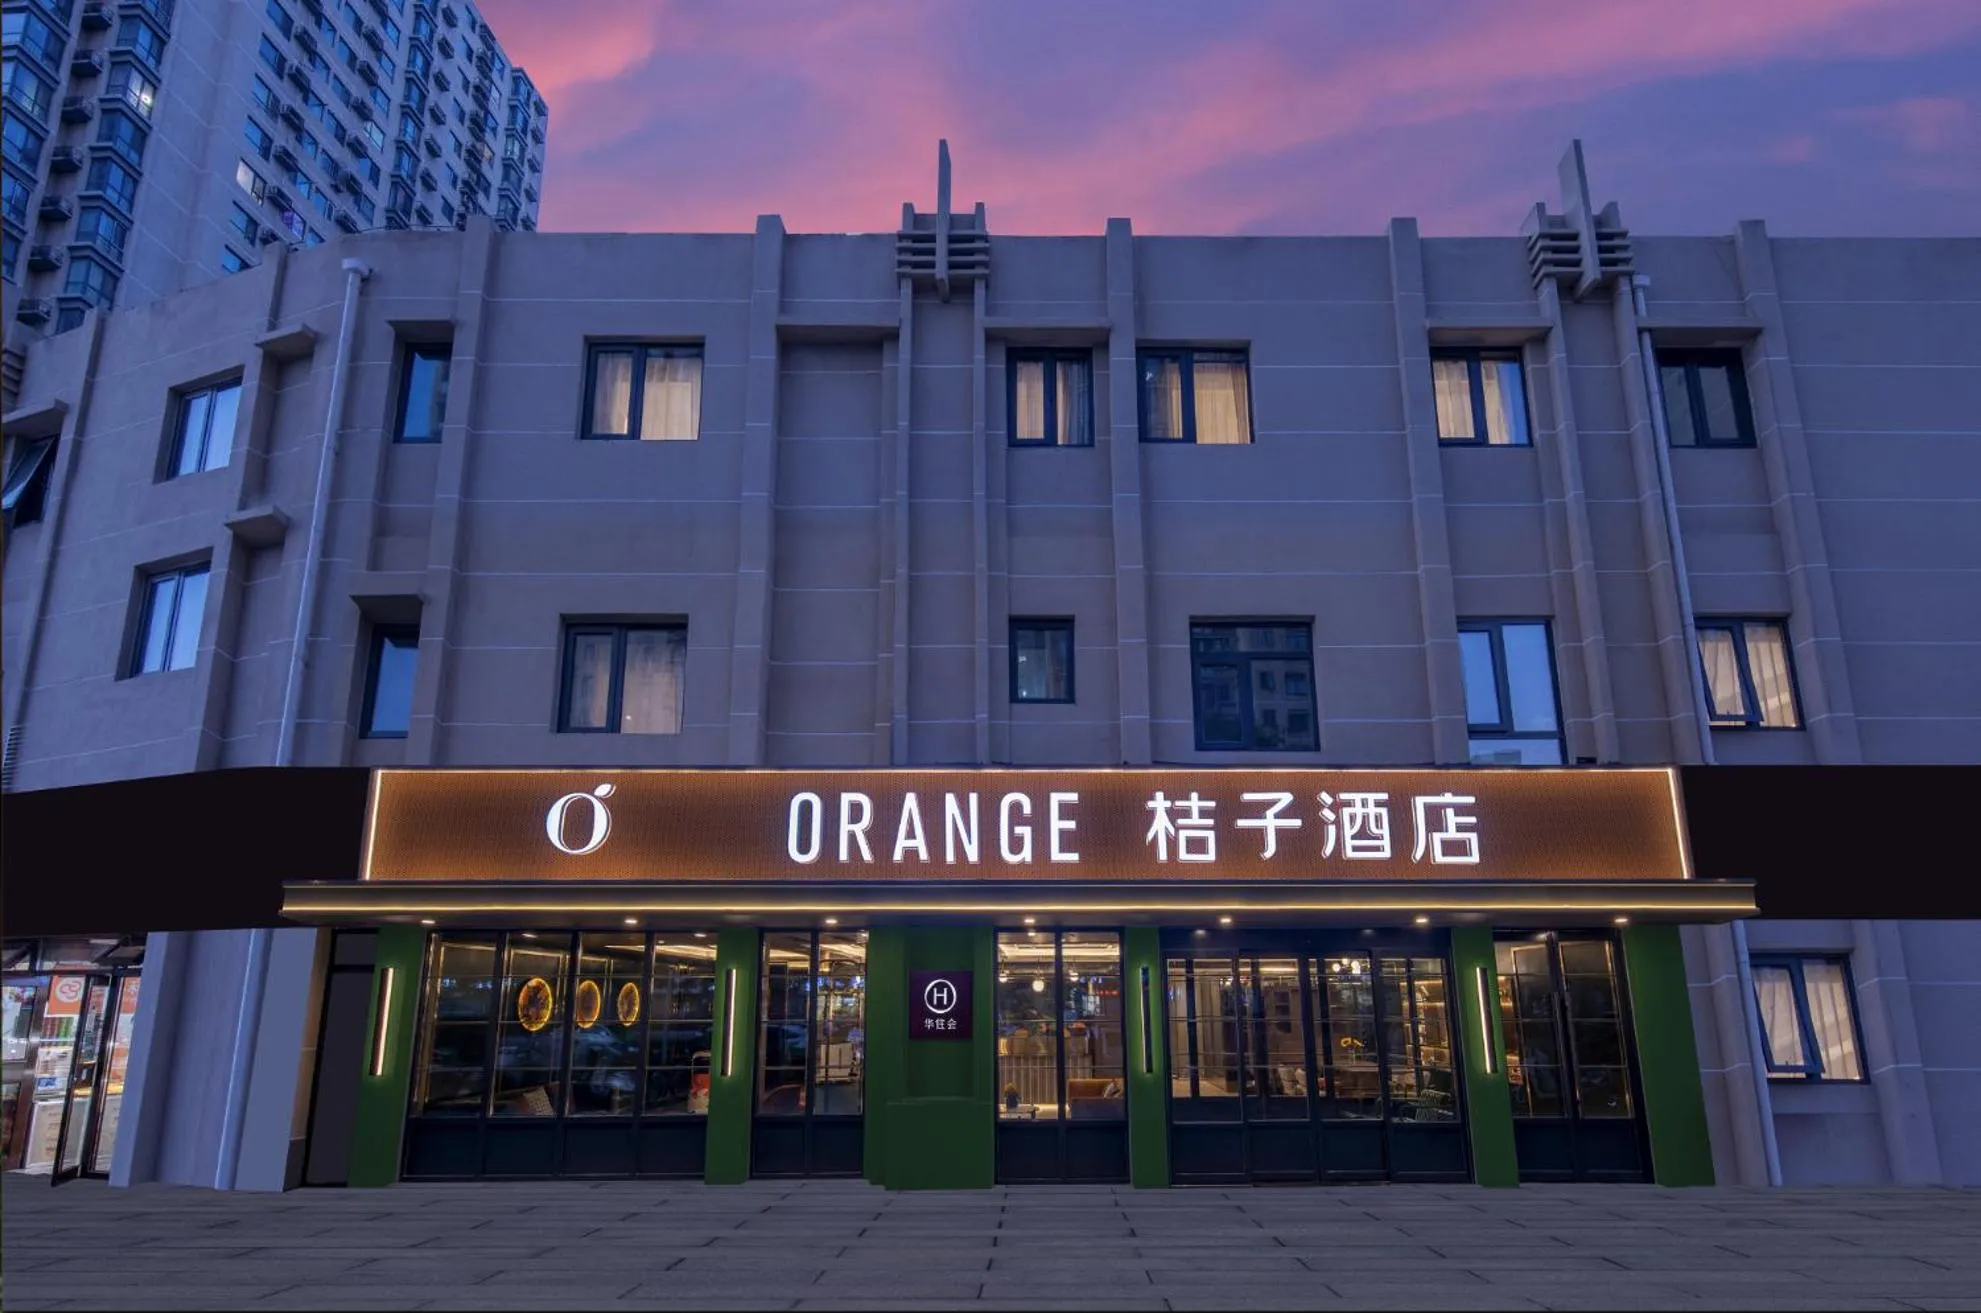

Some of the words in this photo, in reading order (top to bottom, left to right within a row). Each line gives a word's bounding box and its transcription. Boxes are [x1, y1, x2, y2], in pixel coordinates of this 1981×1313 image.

[787, 792, 1080, 864] ORANGE
[1146, 791, 1480, 864] 桔子酒店
[924, 1017, 957, 1030] 华住会
